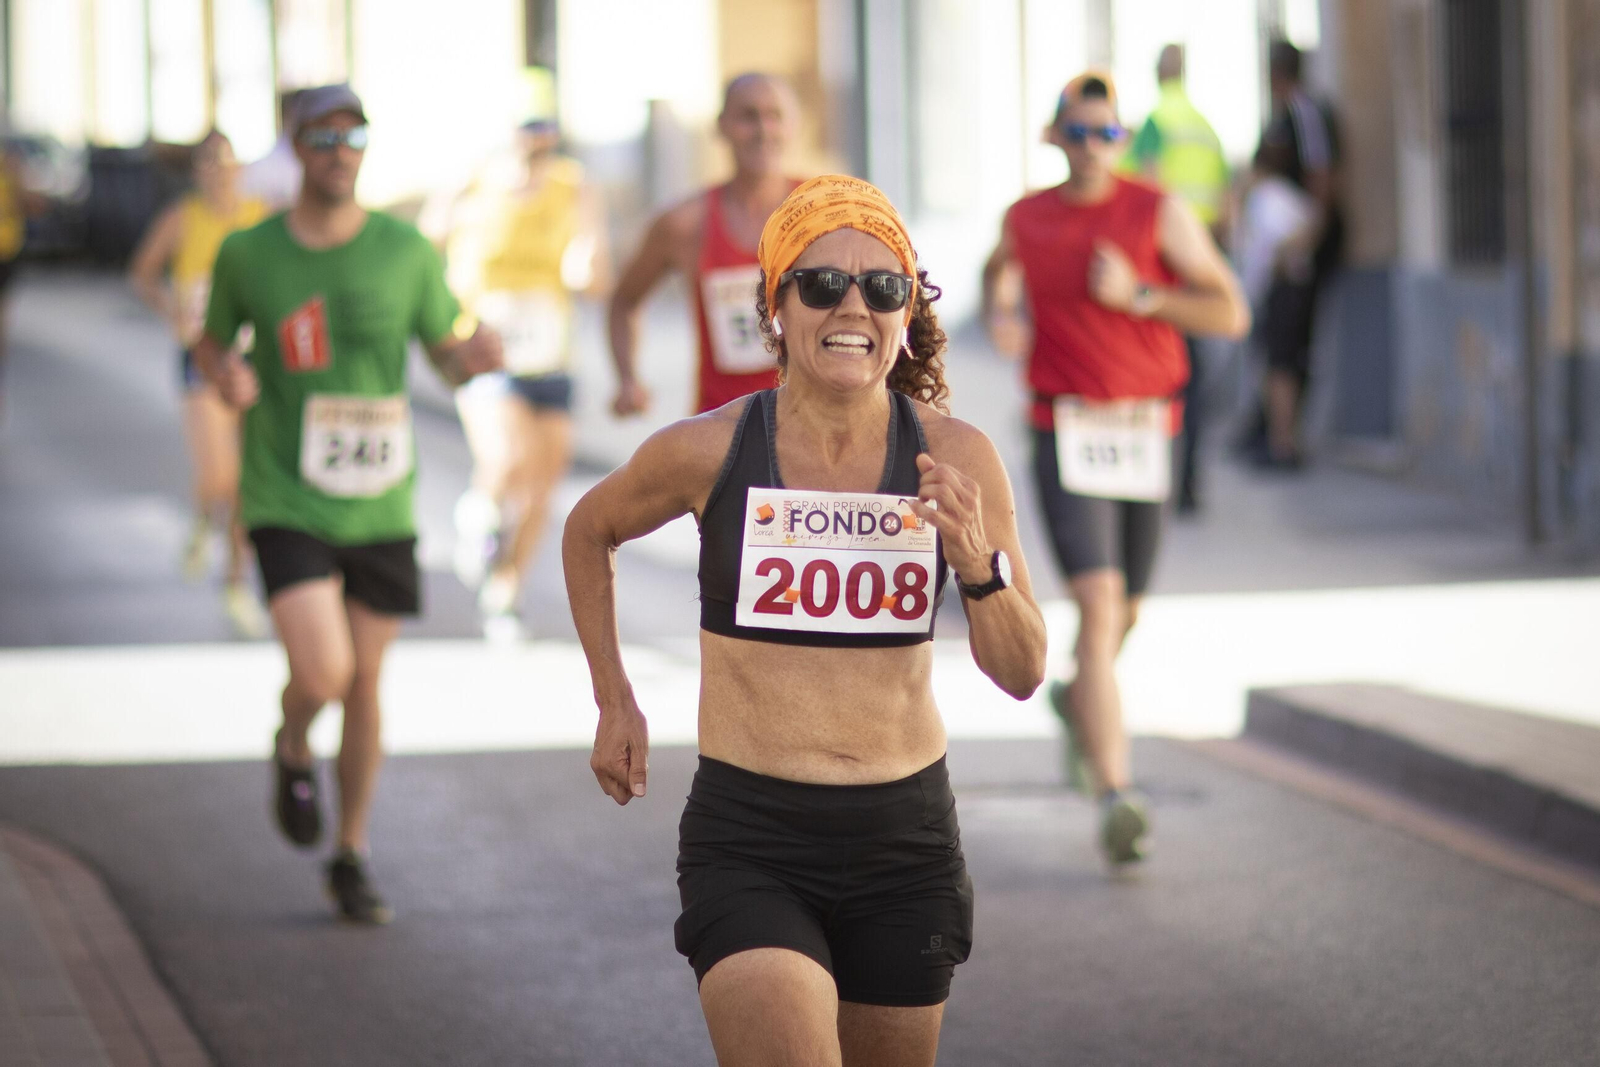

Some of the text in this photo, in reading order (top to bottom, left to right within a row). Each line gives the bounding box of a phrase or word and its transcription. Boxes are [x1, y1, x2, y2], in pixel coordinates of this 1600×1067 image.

[790, 500, 829, 511] GRAN
[833, 501, 882, 513] PREMIO
[789, 509, 903, 537] FONDO
[884, 519, 898, 529] 24
[752, 557, 929, 621] 2008
